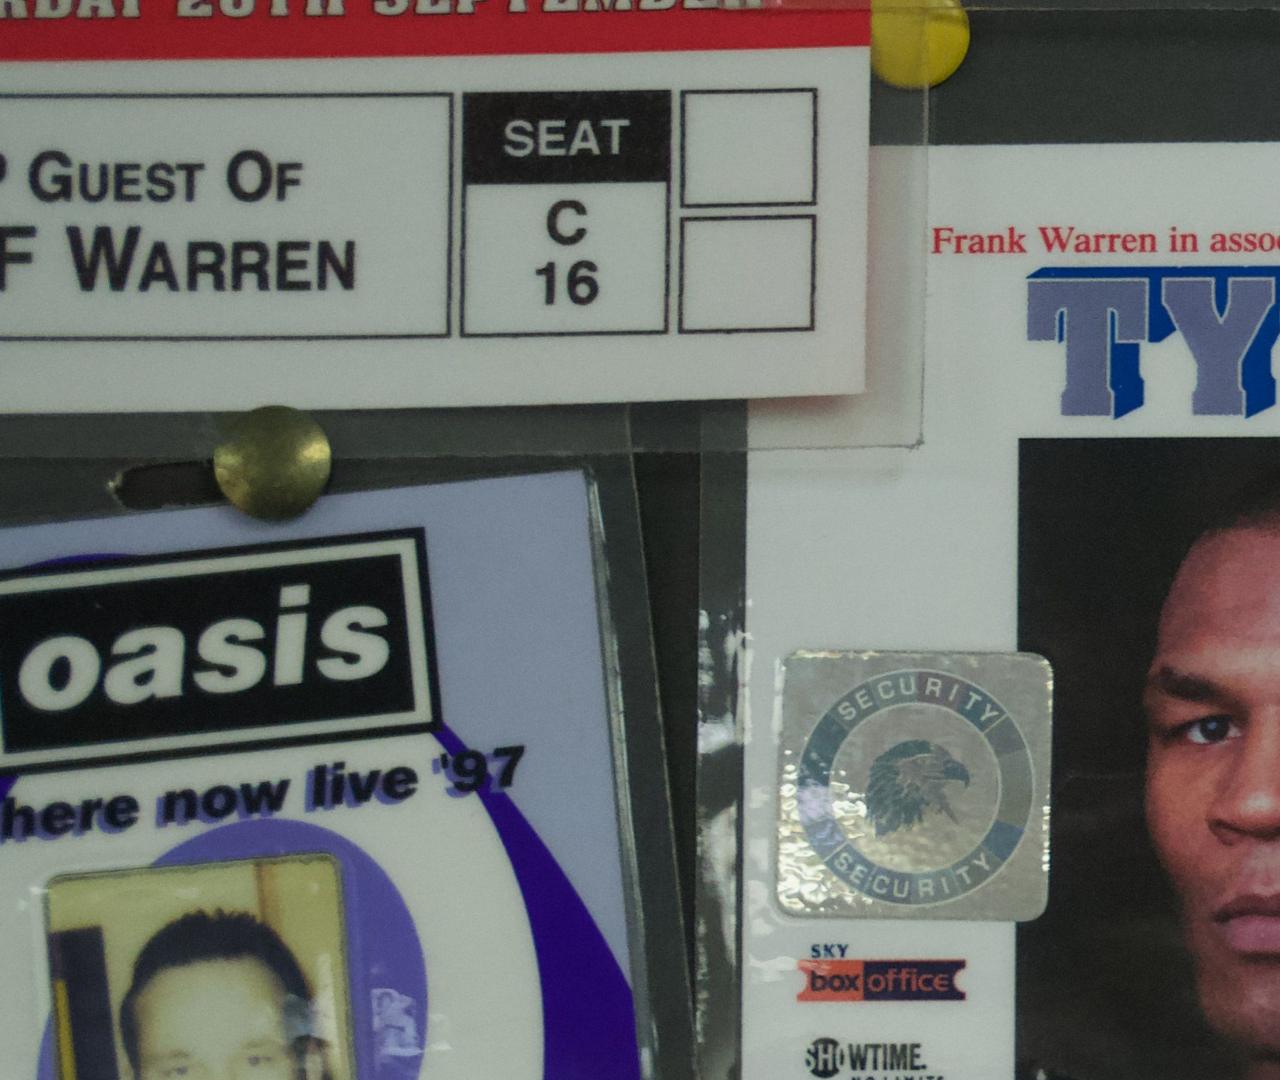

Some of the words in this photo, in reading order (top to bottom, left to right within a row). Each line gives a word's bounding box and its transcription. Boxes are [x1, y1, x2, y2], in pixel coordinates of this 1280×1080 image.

[503, 120, 630, 157] SEAT
[546, 200, 588, 246] C
[932, 227, 1026, 254] Frank
[1039, 227, 1157, 254] Warren
[1170, 226, 1198, 253] in
[535, 259, 600, 306] 16
[18, 584, 390, 712] oasis
[838, 677, 1000, 723] SECURITY
[3, 795, 139, 840] here
[160, 778, 290, 826] now
[310, 762, 418, 812] live
[832, 849, 991, 899] SECURITY
[811, 944, 849, 958] SKY
